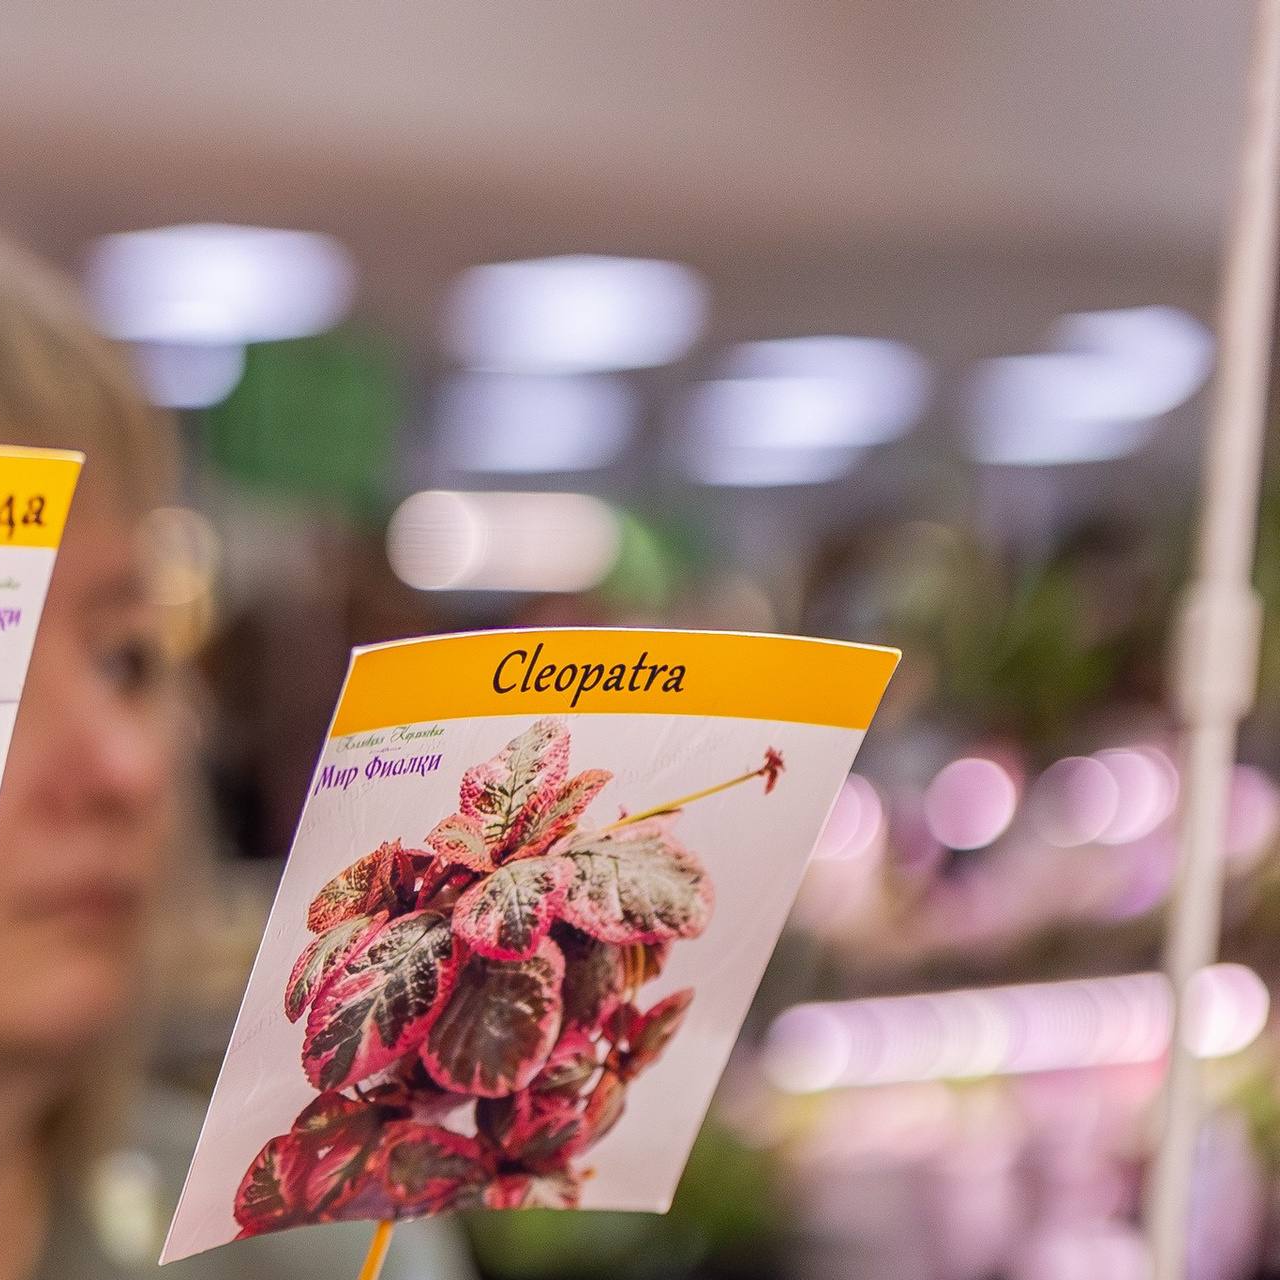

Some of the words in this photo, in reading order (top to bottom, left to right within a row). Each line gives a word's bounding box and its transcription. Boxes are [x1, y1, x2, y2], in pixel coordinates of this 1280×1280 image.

[492, 642, 686, 708] Cleopatra
[314, 765, 359, 797] Мир
[364, 753, 444, 780] Фиалки
